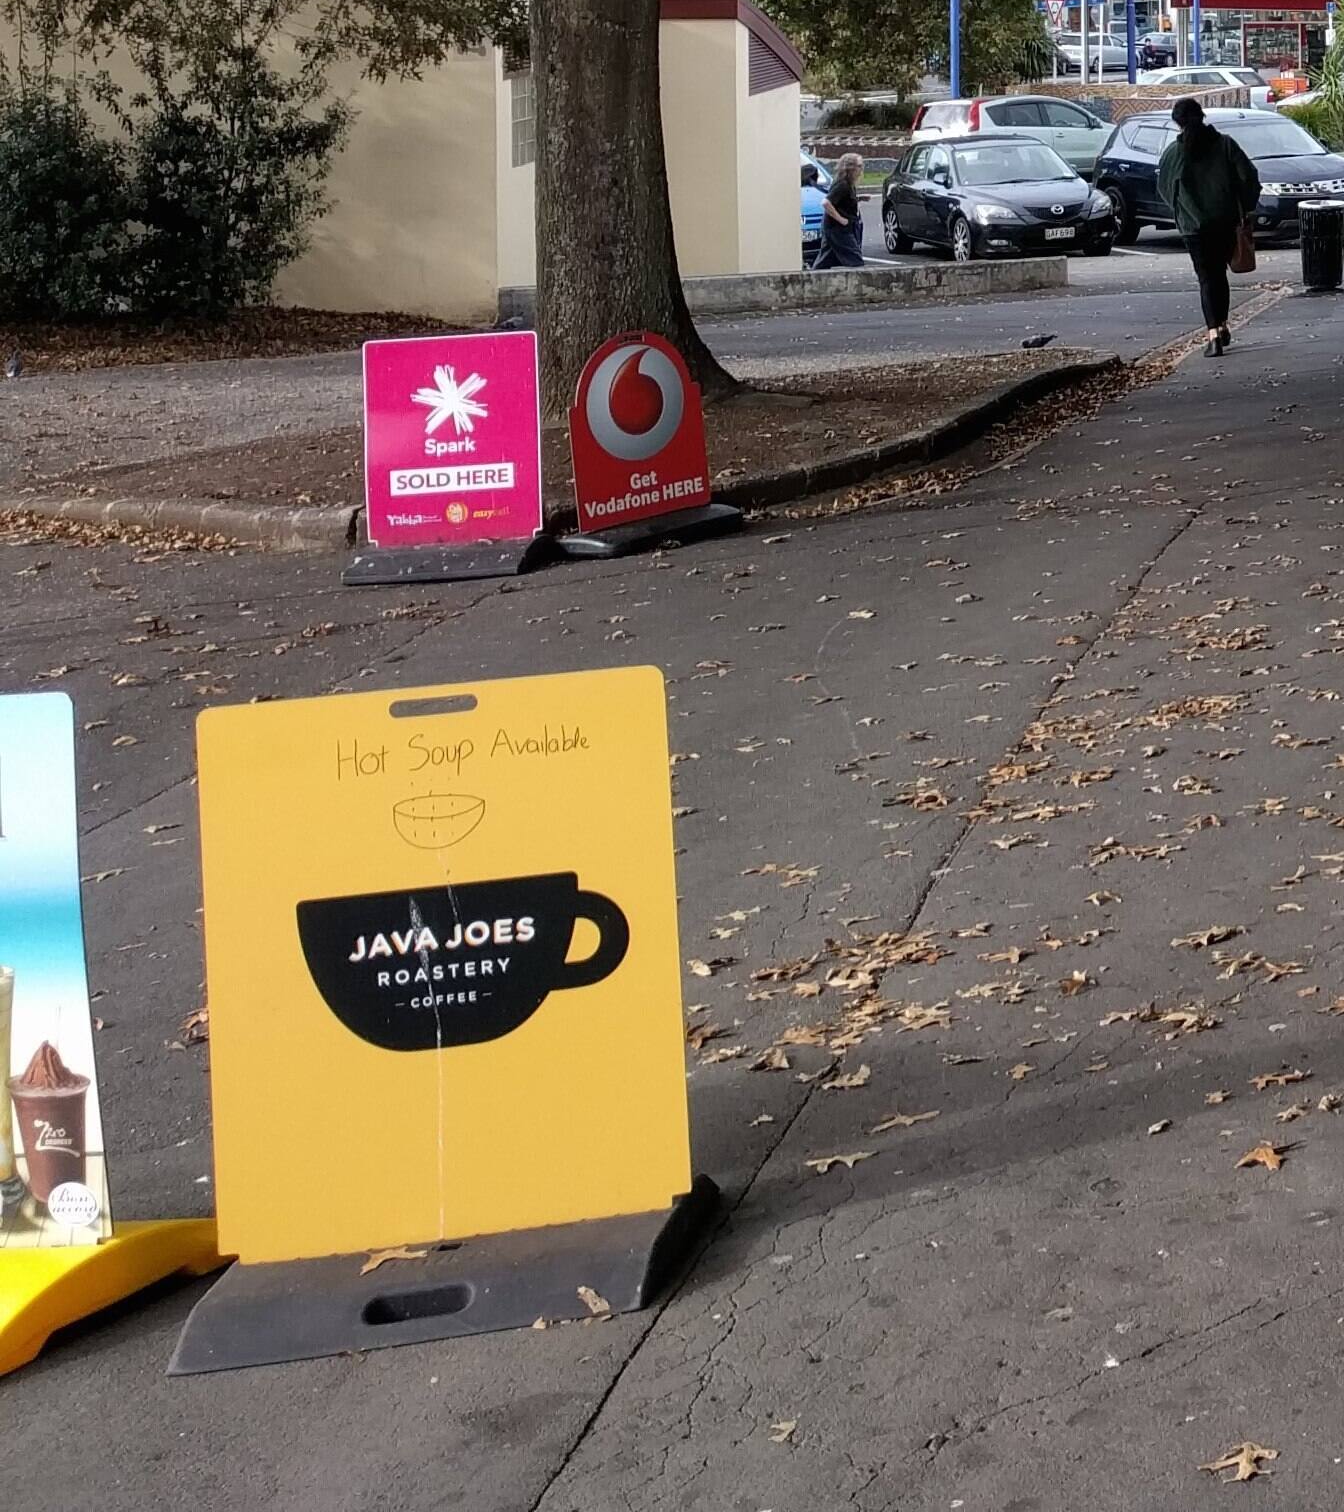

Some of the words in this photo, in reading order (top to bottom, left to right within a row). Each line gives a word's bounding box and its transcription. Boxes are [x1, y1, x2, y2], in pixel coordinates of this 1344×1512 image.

[424, 436, 476, 457] Spark
[396, 470, 451, 491] SOLD
[456, 467, 510, 487] HERE
[630, 472, 658, 489] Get
[585, 487, 660, 519] Vodafone
[662, 476, 704, 501] HERE
[336, 737, 391, 781] Hot
[408, 732, 475, 776] Soup
[490, 724, 591, 759] Available
[348, 926, 439, 964] JAVA
[444, 915, 535, 949] JOES
[377, 956, 512, 988] ROASTERY
[409, 991, 479, 1010] COFFEE
